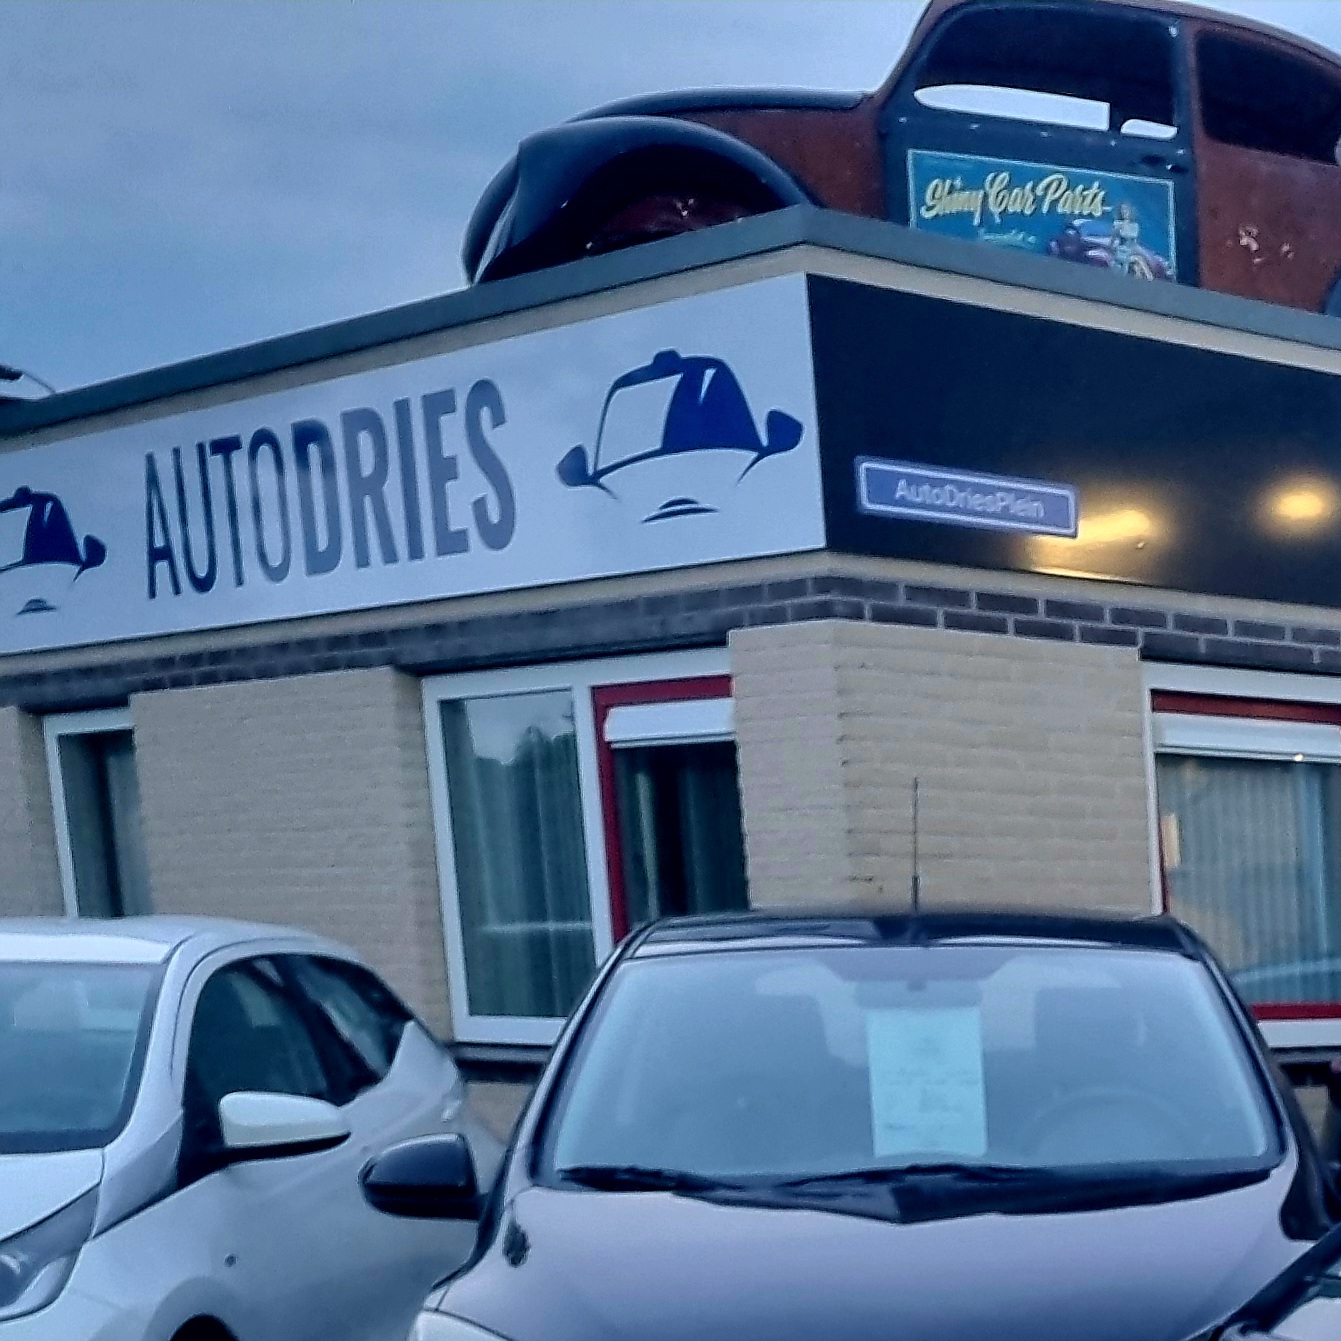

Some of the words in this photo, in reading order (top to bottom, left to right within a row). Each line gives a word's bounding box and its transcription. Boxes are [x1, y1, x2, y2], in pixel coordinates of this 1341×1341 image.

[985, 171, 1037, 223] Car
[1036, 173, 1112, 217] Parts
[144, 378, 517, 599] AUTODRIES
